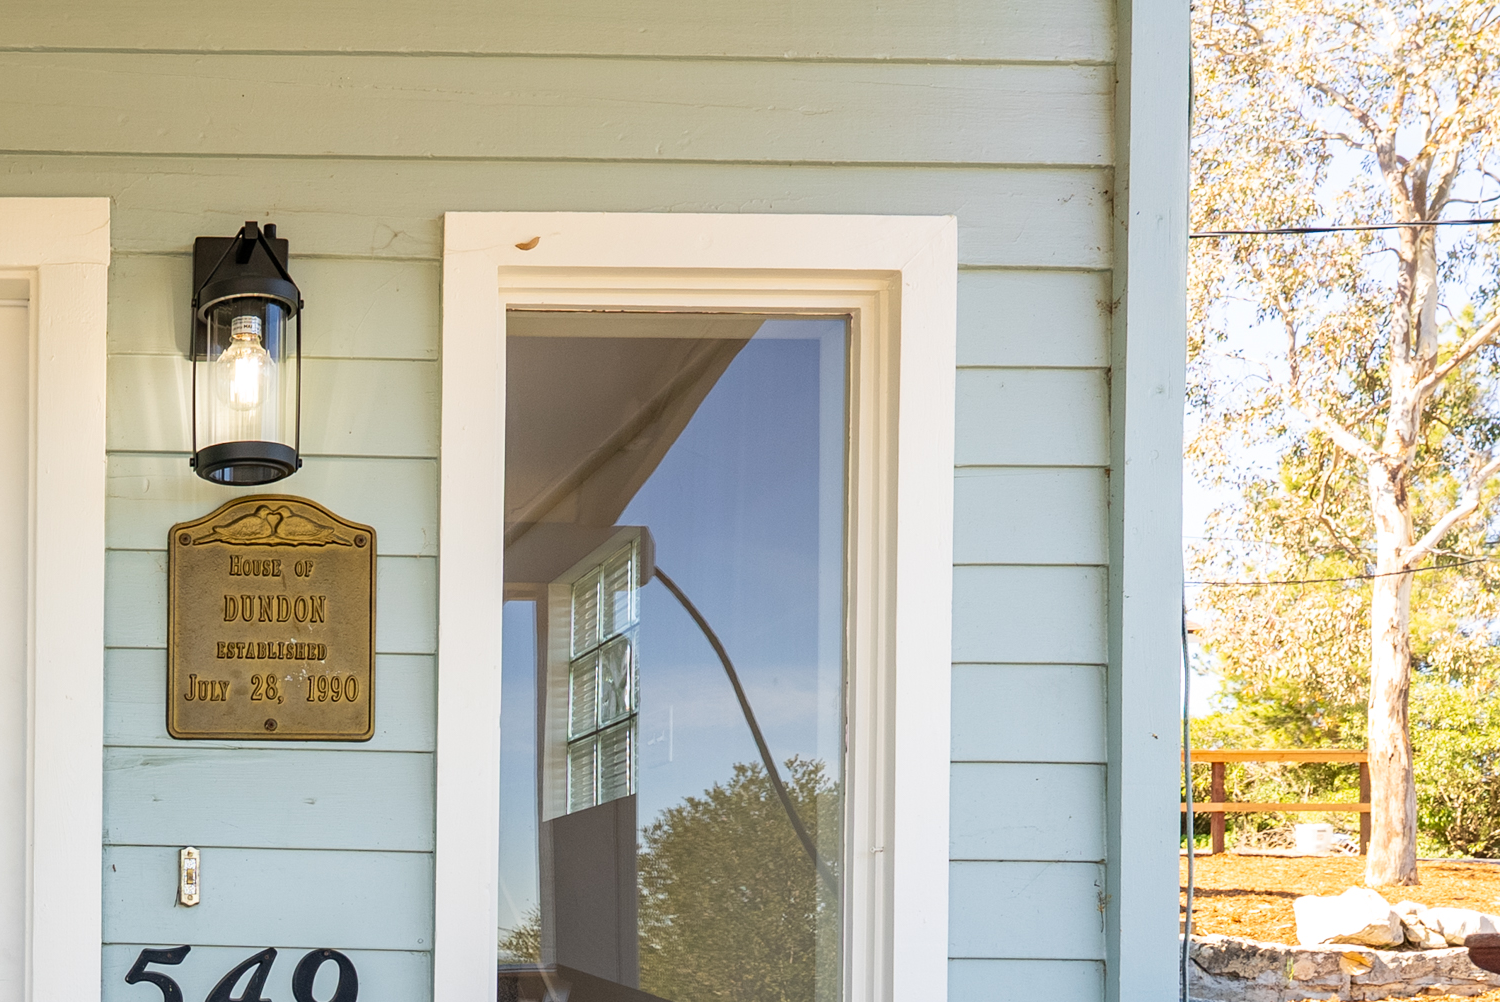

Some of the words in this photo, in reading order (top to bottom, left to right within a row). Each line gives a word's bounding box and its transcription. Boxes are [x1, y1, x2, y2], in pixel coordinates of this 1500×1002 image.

[223, 594, 326, 623] DUNDON
[216, 641, 328, 661] ESTABLISHED
[250, 673, 284, 704] 28,
[307, 674, 360, 702] 1990
